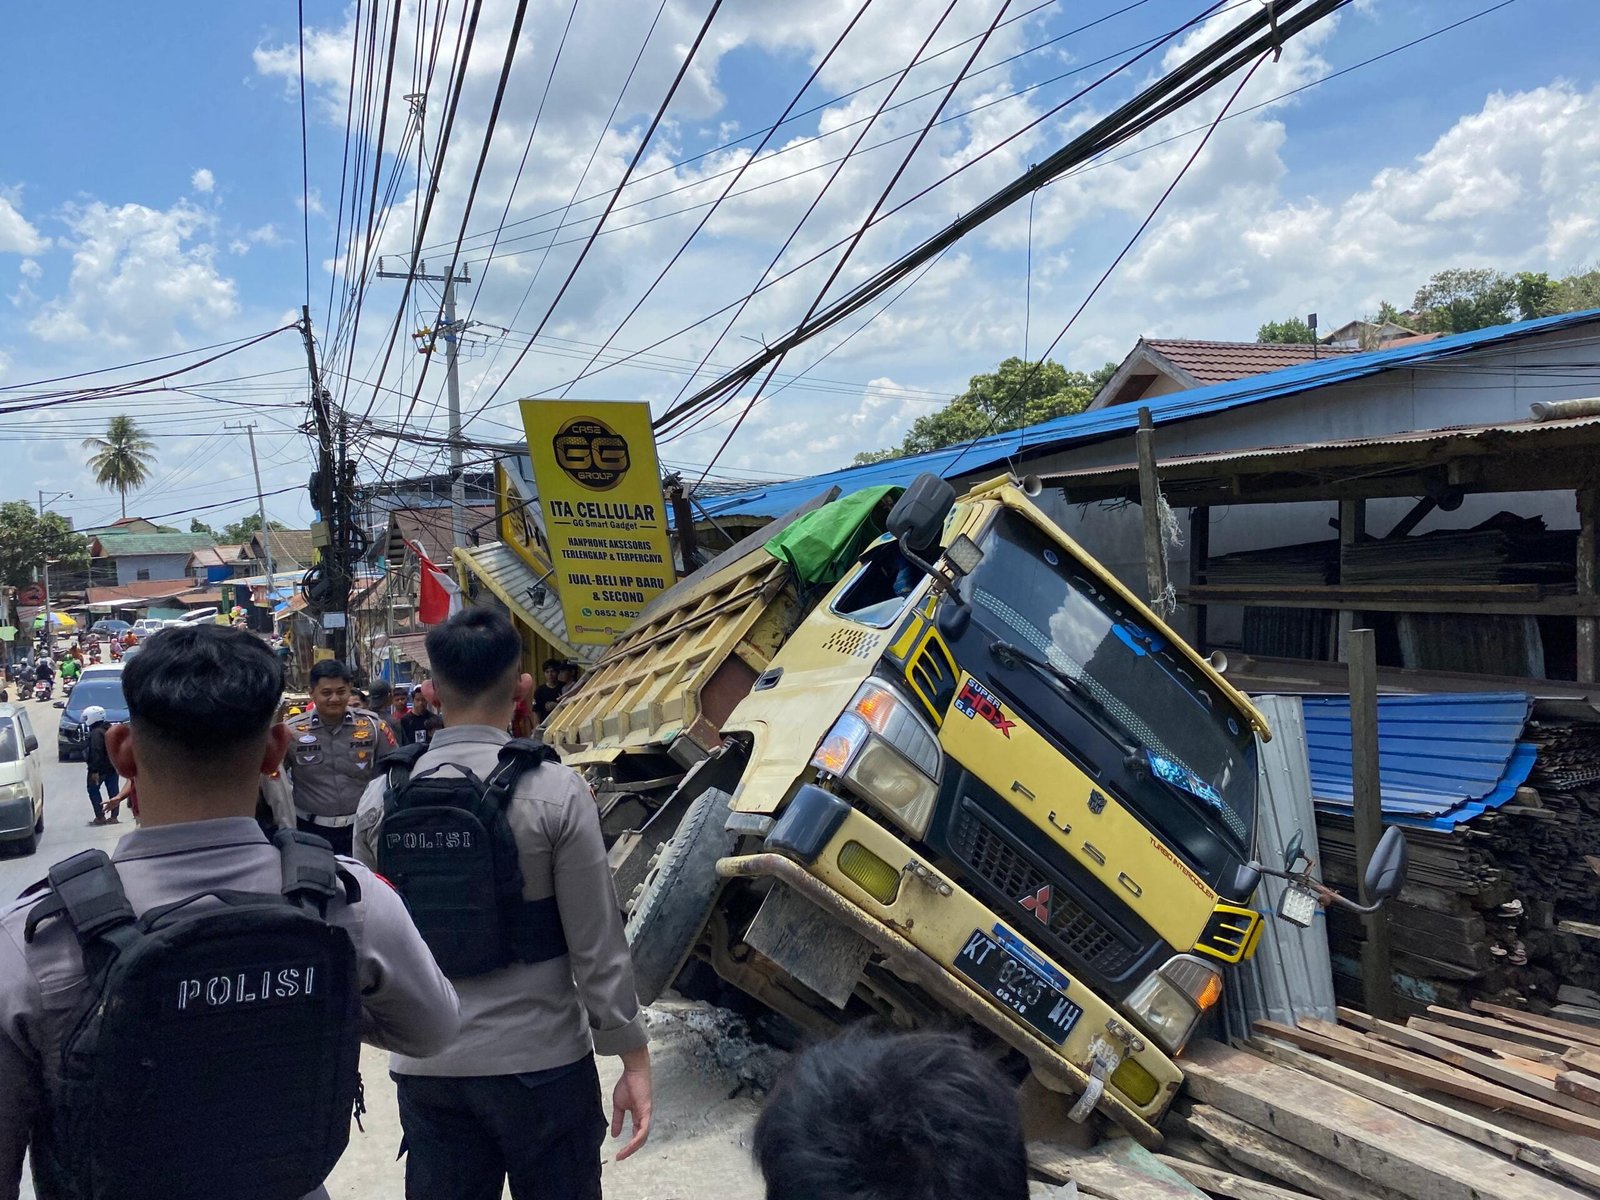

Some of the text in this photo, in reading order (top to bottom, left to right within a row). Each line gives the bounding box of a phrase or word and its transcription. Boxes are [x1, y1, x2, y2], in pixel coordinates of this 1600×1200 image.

[571, 425, 601, 434] CASE
[578, 472, 613, 480] GROUP
[550, 501, 655, 521] ITA CELLULAR
[572, 519, 638, 531] GG Smart Gadget
[567, 537, 652, 551] HANPHONE AKSESORIS
[561, 549, 608, 561] TERLENGKAP
[616, 552, 663, 564] TERPERCAYA
[568, 573, 665, 590] JUAL-BELI HP BARU
[592, 591, 644, 603] & SECOND
[594, 609, 617, 618] 0852
[967, 678, 1002, 710] SUPER
[954, 699, 976, 719] 6.6
[386, 832, 470, 849] POLISI
[1010, 780, 1143, 898] FUSO
[1149, 836, 1215, 901] TURBO INTERCOOLER
[963, 932, 997, 966] KT
[178, 967, 314, 1010] POLISI
